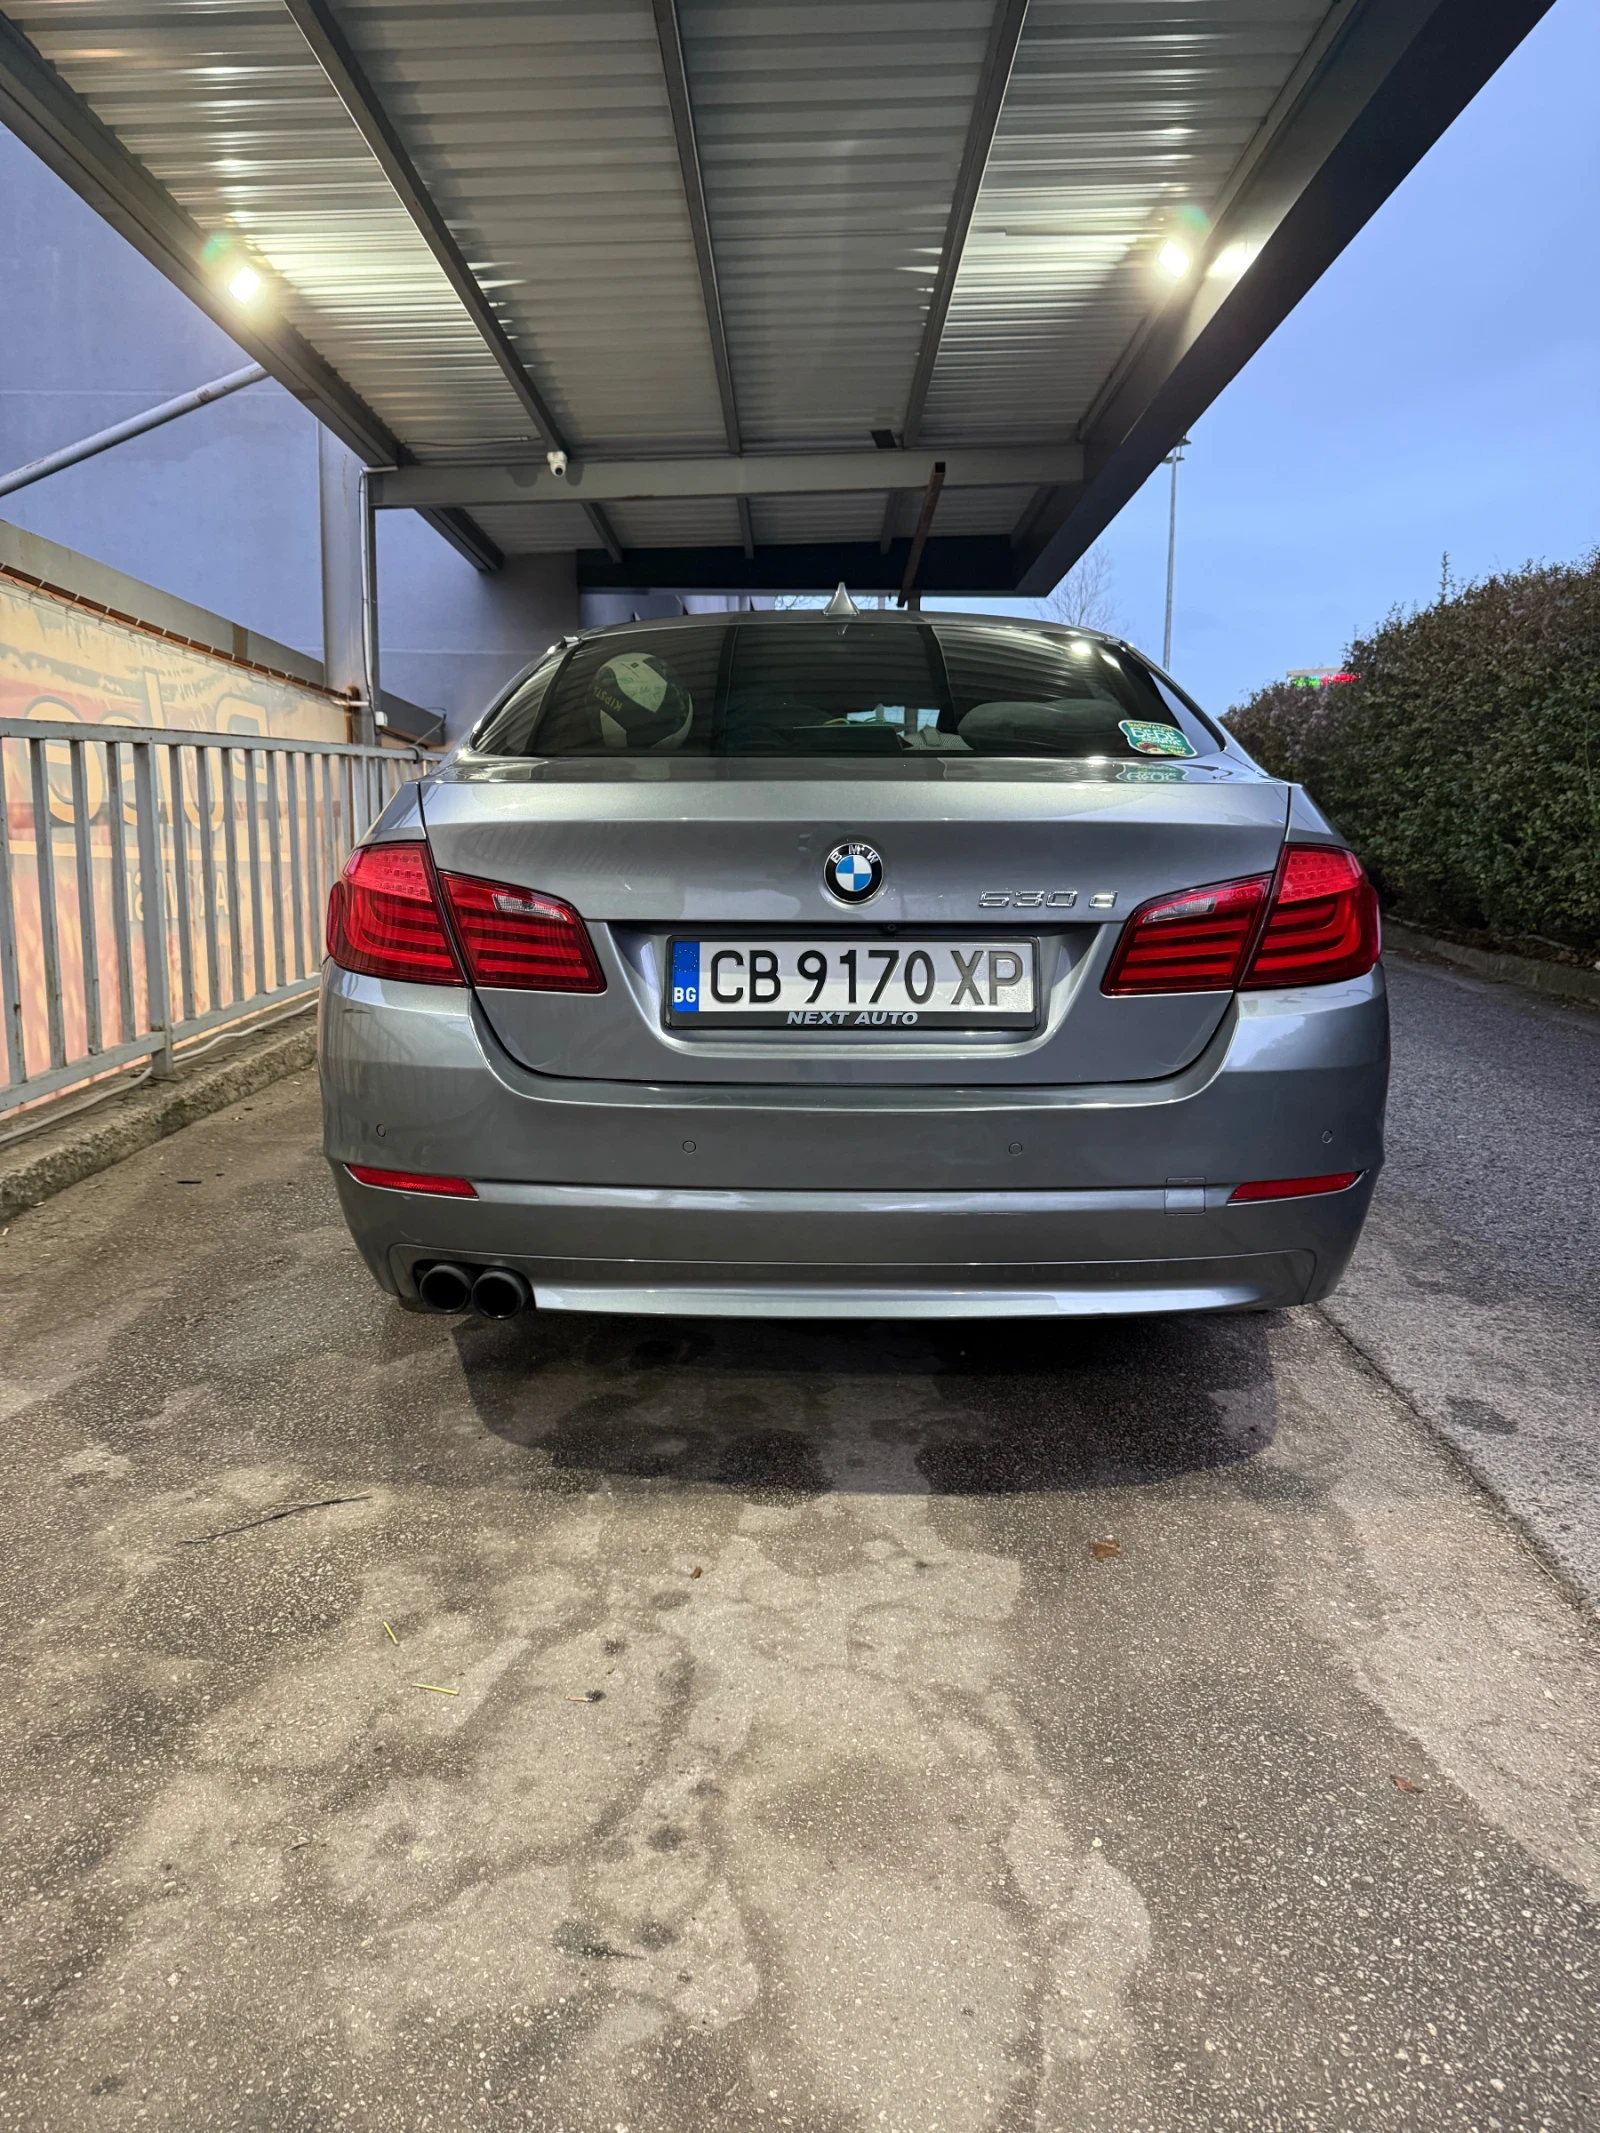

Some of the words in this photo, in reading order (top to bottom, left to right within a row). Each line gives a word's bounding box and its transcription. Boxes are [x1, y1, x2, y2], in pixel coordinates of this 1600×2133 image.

[830, 844, 879, 864] BMW
[979, 888, 1078, 908] 530
[1088, 888, 1118, 908] d
[711, 950, 781, 1004] CB
[797, 950, 936, 1004] 9170
[950, 950, 1023, 1006] XP
[673, 987, 697, 1003] BG
[787, 1011, 849, 1025] NEXT
[854, 1011, 919, 1025] AUTO
